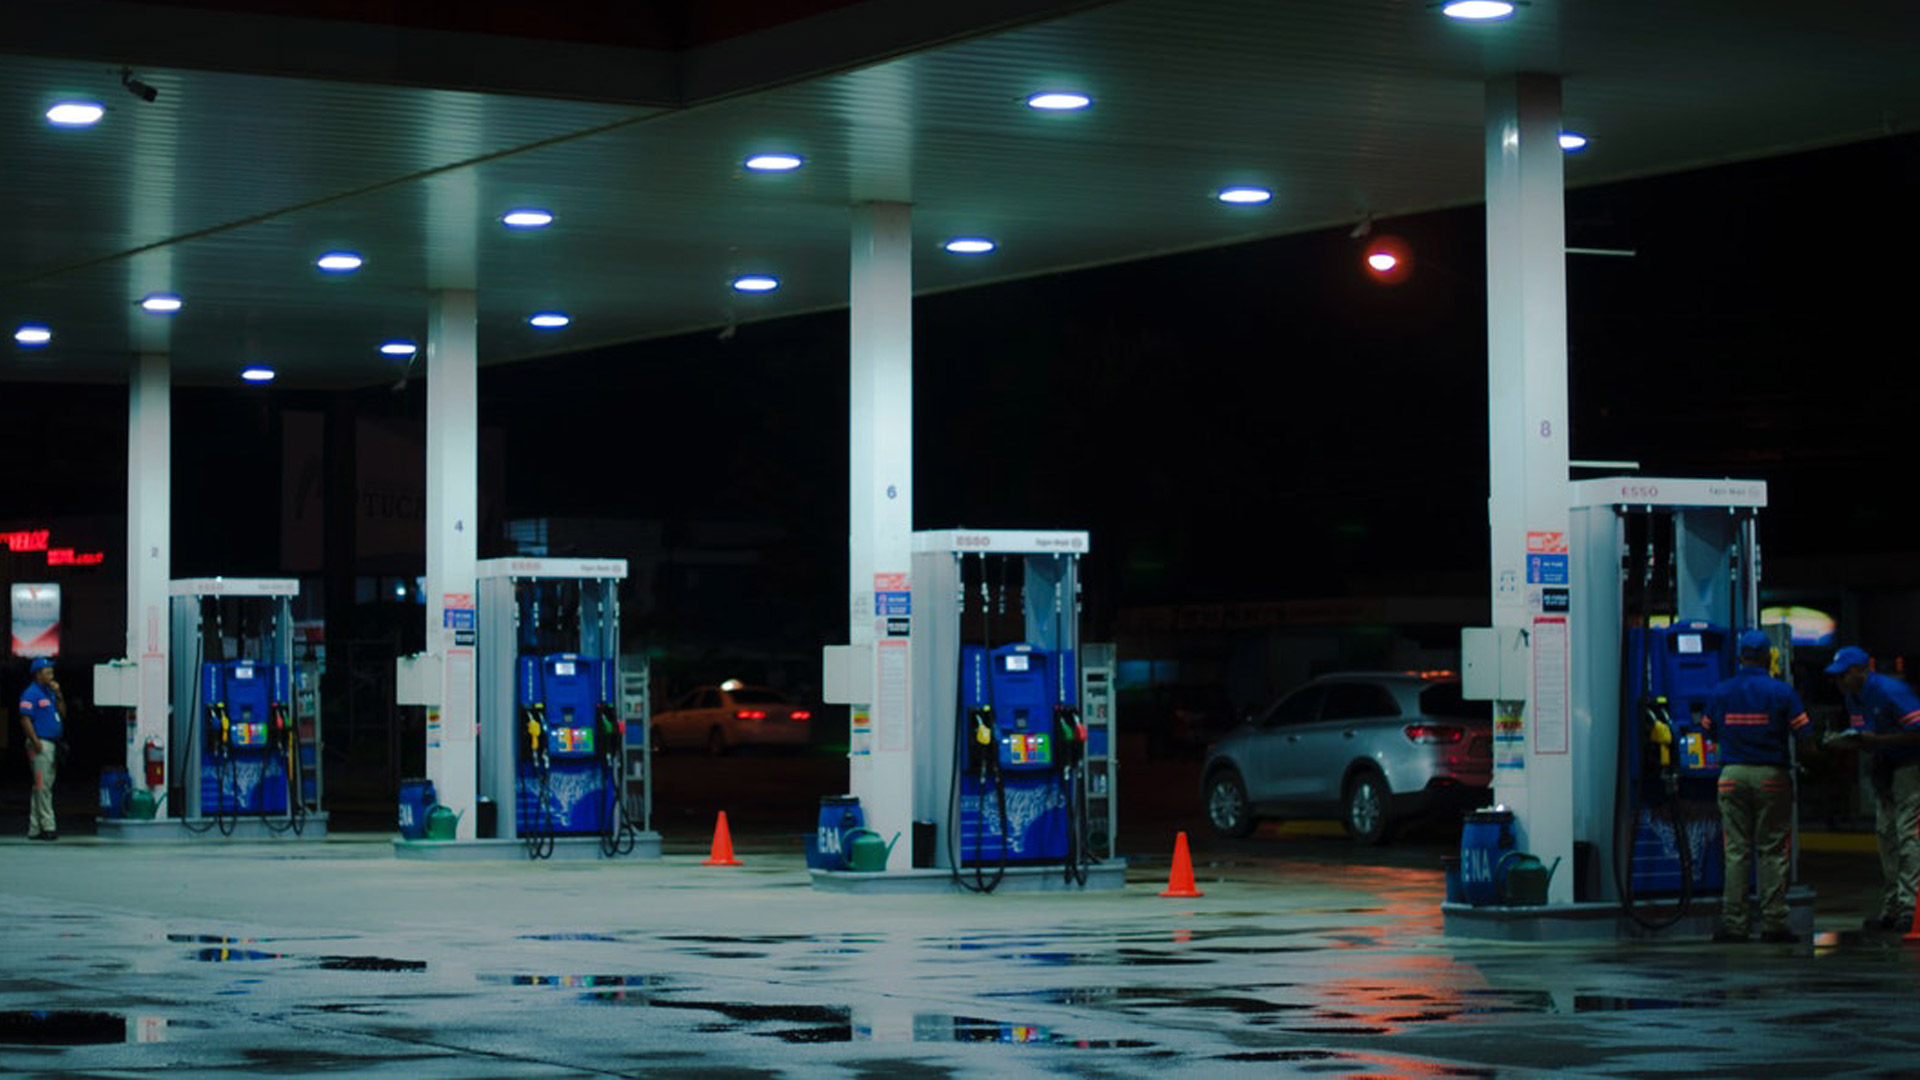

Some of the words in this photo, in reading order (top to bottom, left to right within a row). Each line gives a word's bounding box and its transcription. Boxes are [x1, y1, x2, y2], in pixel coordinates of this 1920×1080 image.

[1539, 419, 1552, 438] 8
[886, 484, 897, 500] 6
[1621, 486, 1659, 497] ESSO
[454, 519, 464, 533] 4
[956, 535, 991, 546] ESSO
